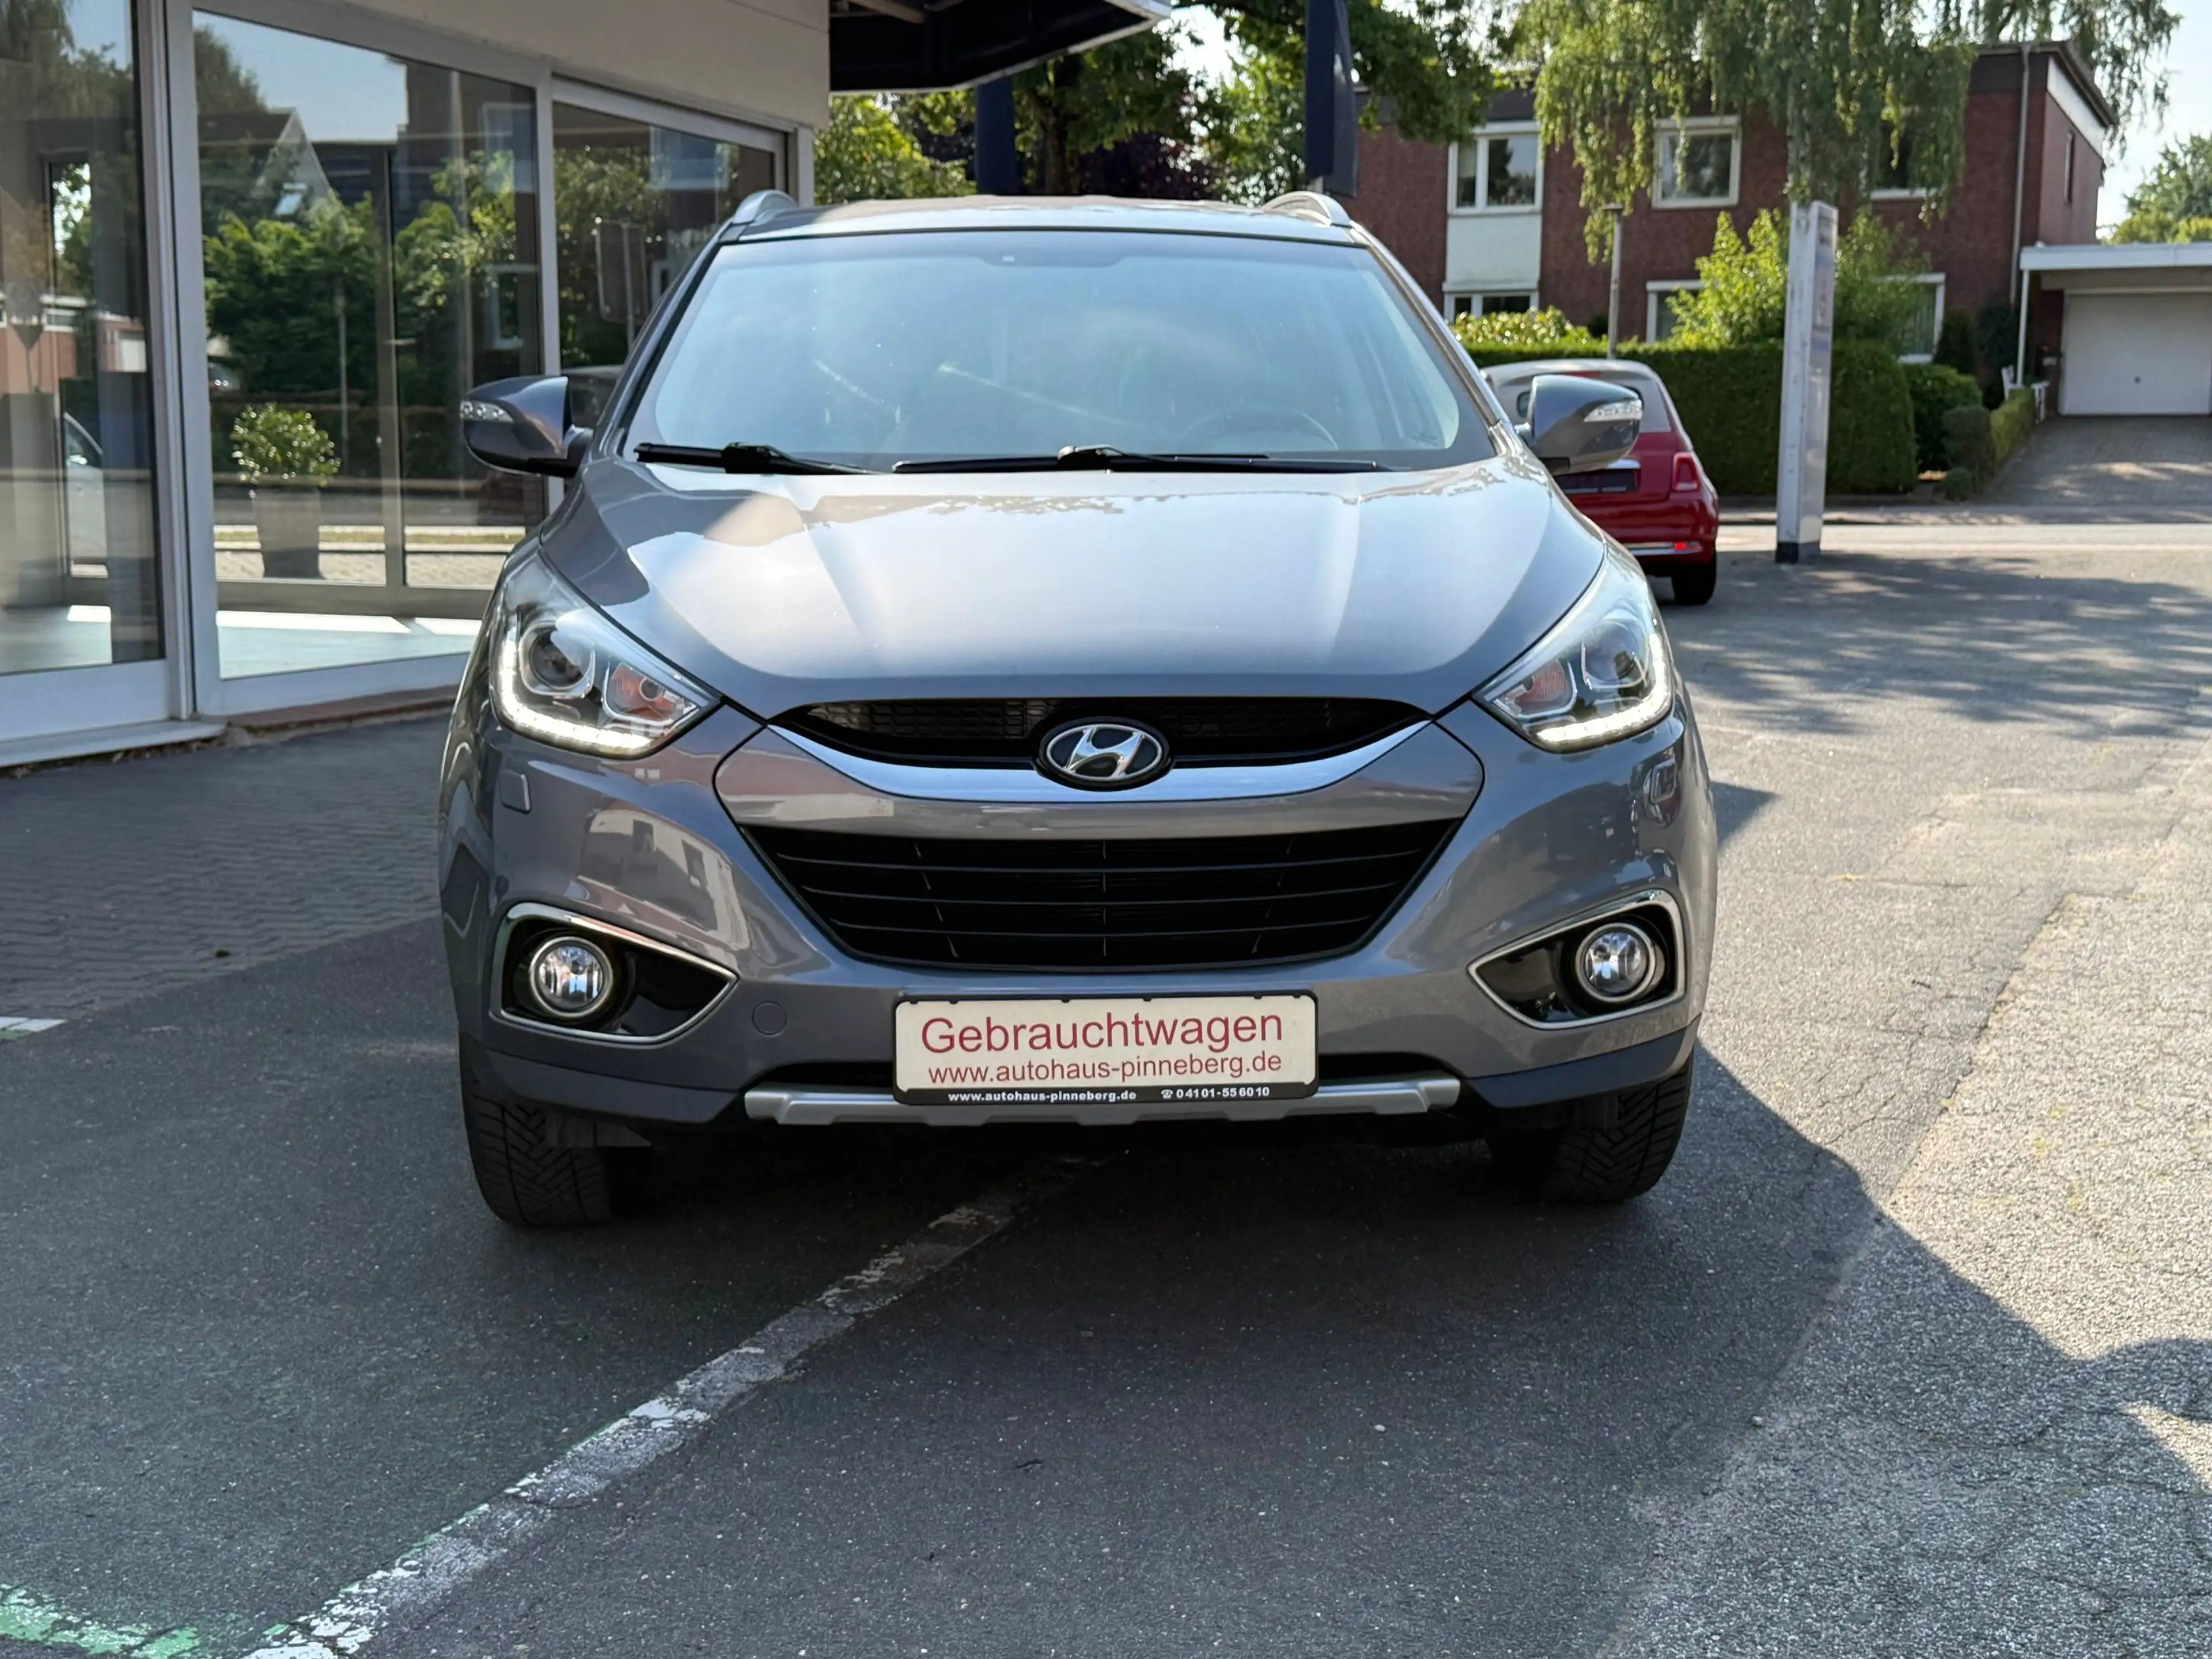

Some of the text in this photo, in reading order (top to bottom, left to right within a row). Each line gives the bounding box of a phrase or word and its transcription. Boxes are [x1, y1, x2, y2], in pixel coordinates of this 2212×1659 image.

[922, 1012, 1282, 1054] Gebrauchtwagen
[928, 1050, 1282, 1084] www.autohaus-pinneberg.de
[948, 1086, 1270, 1103] www.autohaus-pinneberg.de 04101-556010
